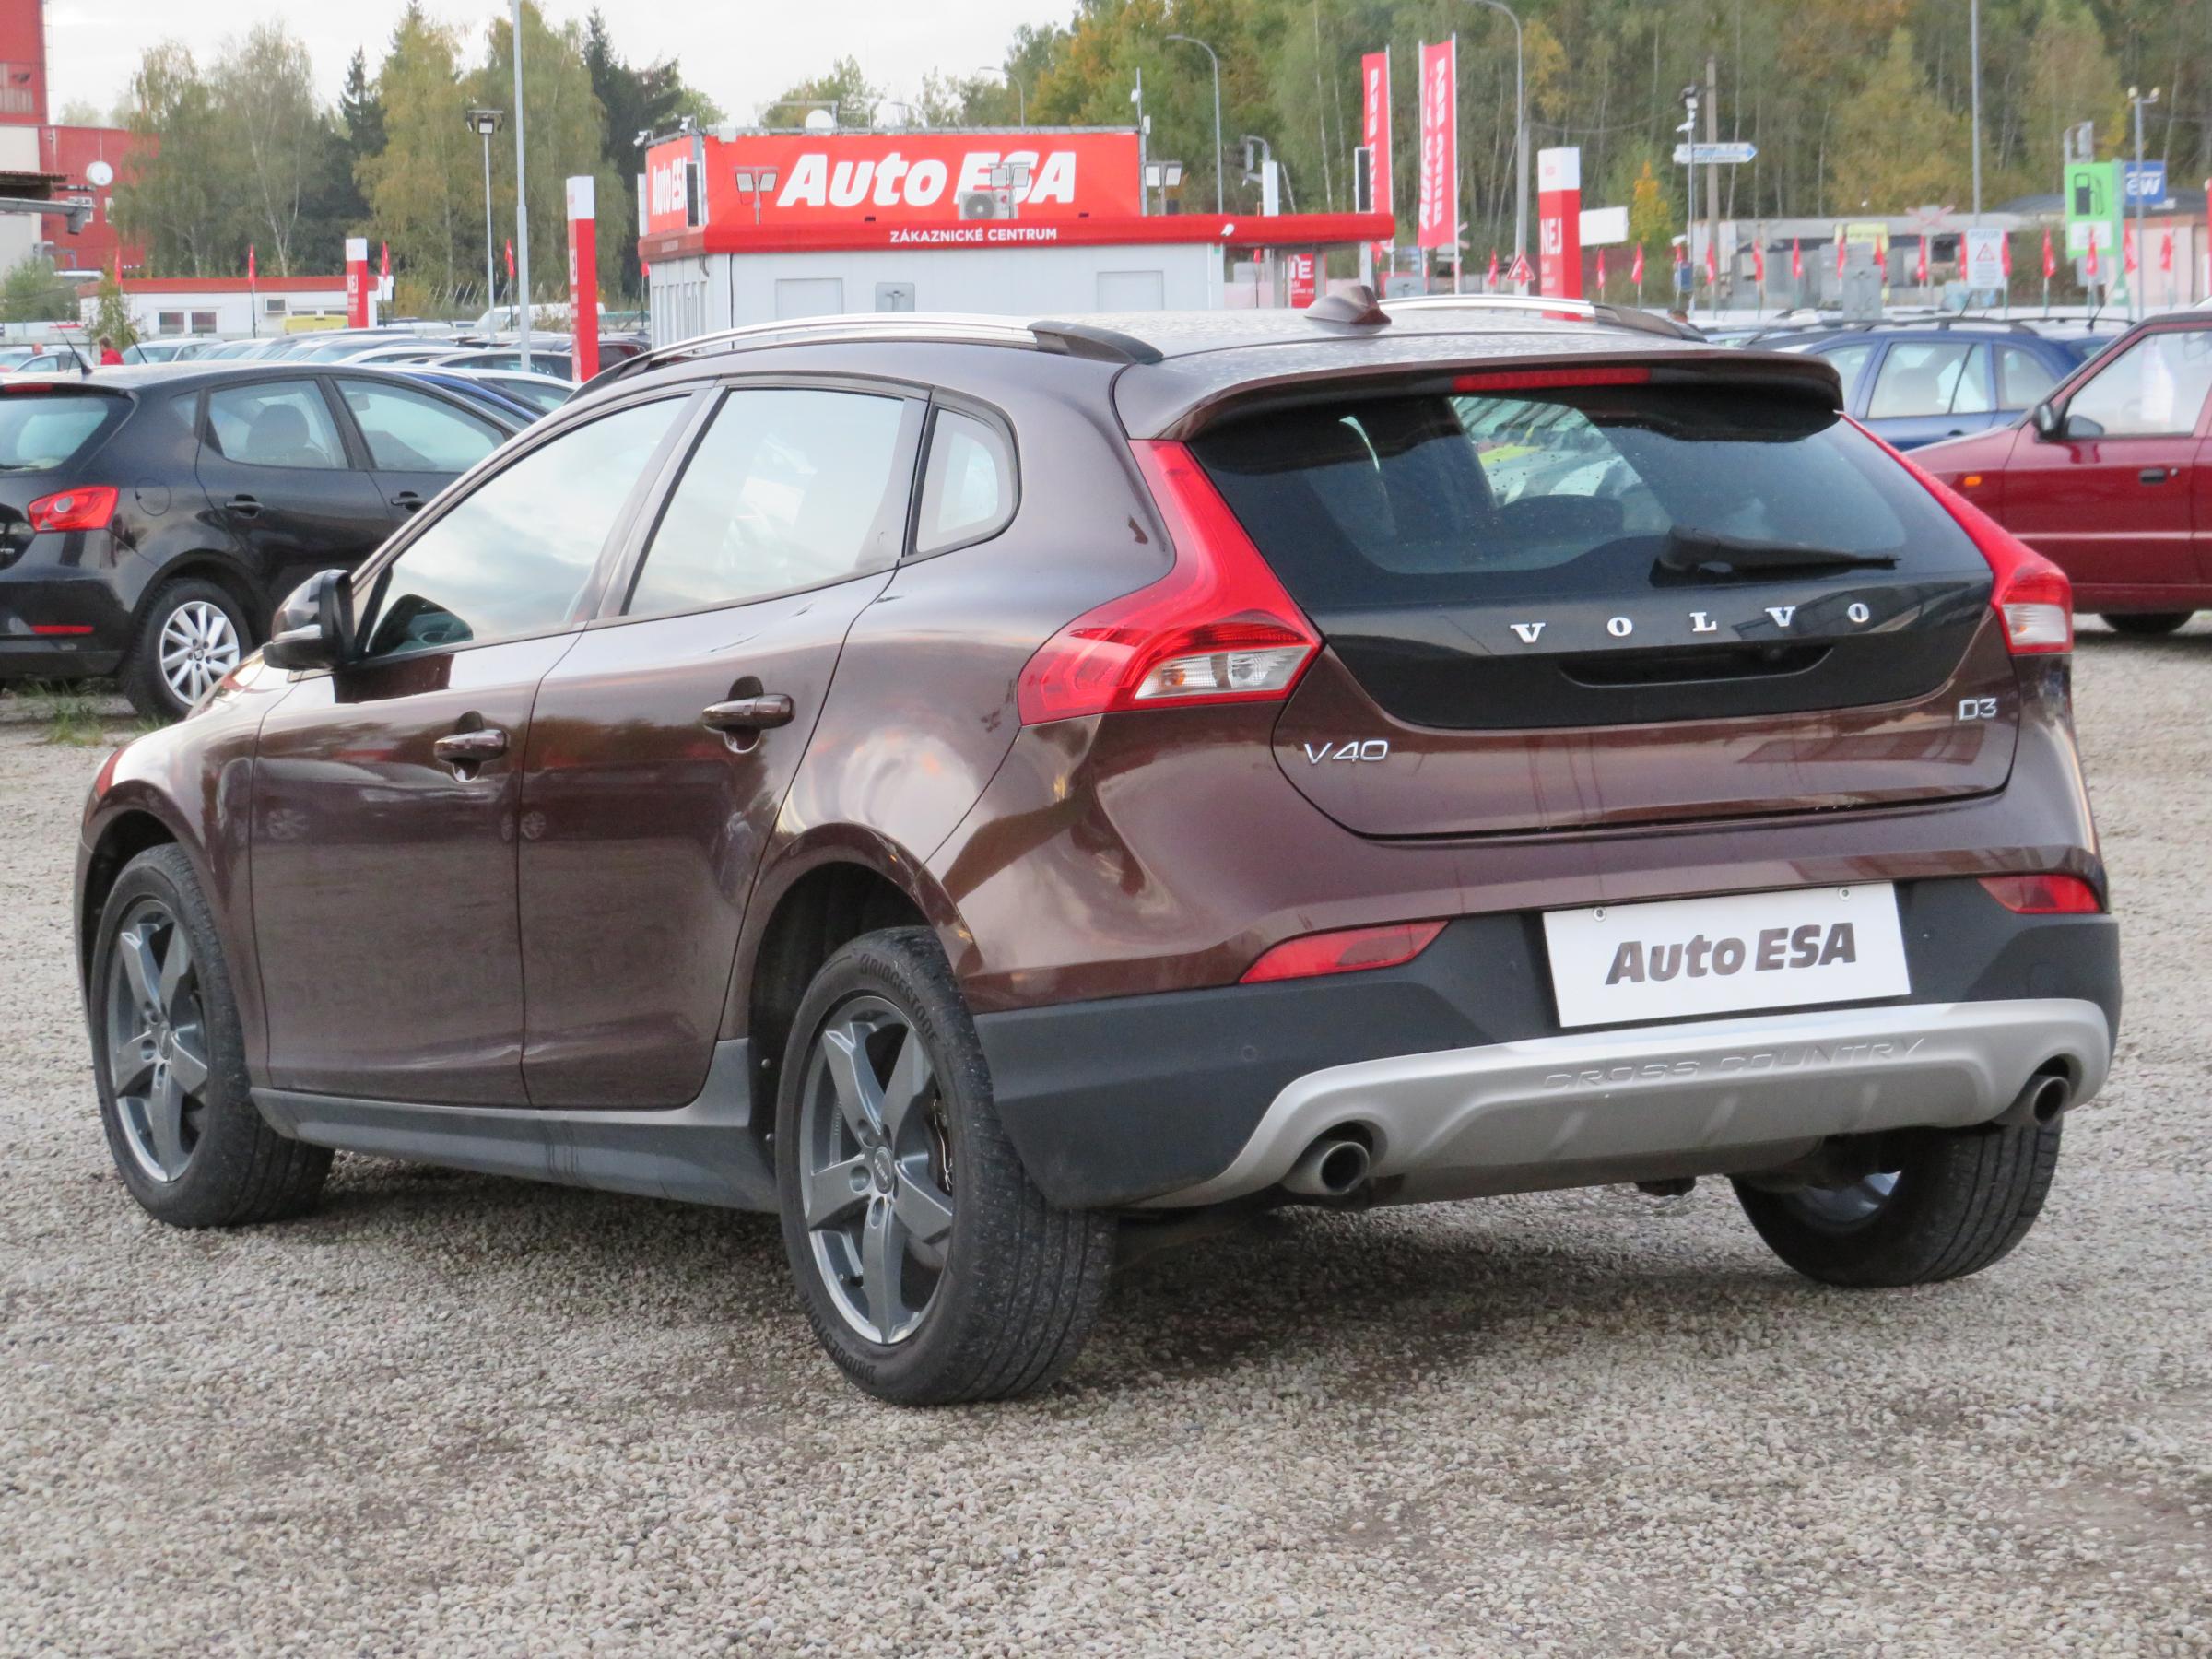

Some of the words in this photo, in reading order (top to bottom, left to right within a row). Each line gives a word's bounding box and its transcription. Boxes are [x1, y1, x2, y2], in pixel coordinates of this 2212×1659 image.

[776, 152, 947, 207] Auto
[889, 227, 983, 243] ZÁKAZNICKÉ
[987, 228, 1058, 241] CENTRUM
[1510, 602, 1871, 643] VOLVO
[1959, 697, 1997, 720] D3
[1304, 739, 1389, 764] V40
[1605, 934, 1746, 986] Auto
[1755, 922, 1857, 972] ESA
[1543, 1061, 1700, 1090] CROSS
[1719, 1037, 1926, 1073] COUNTRY
